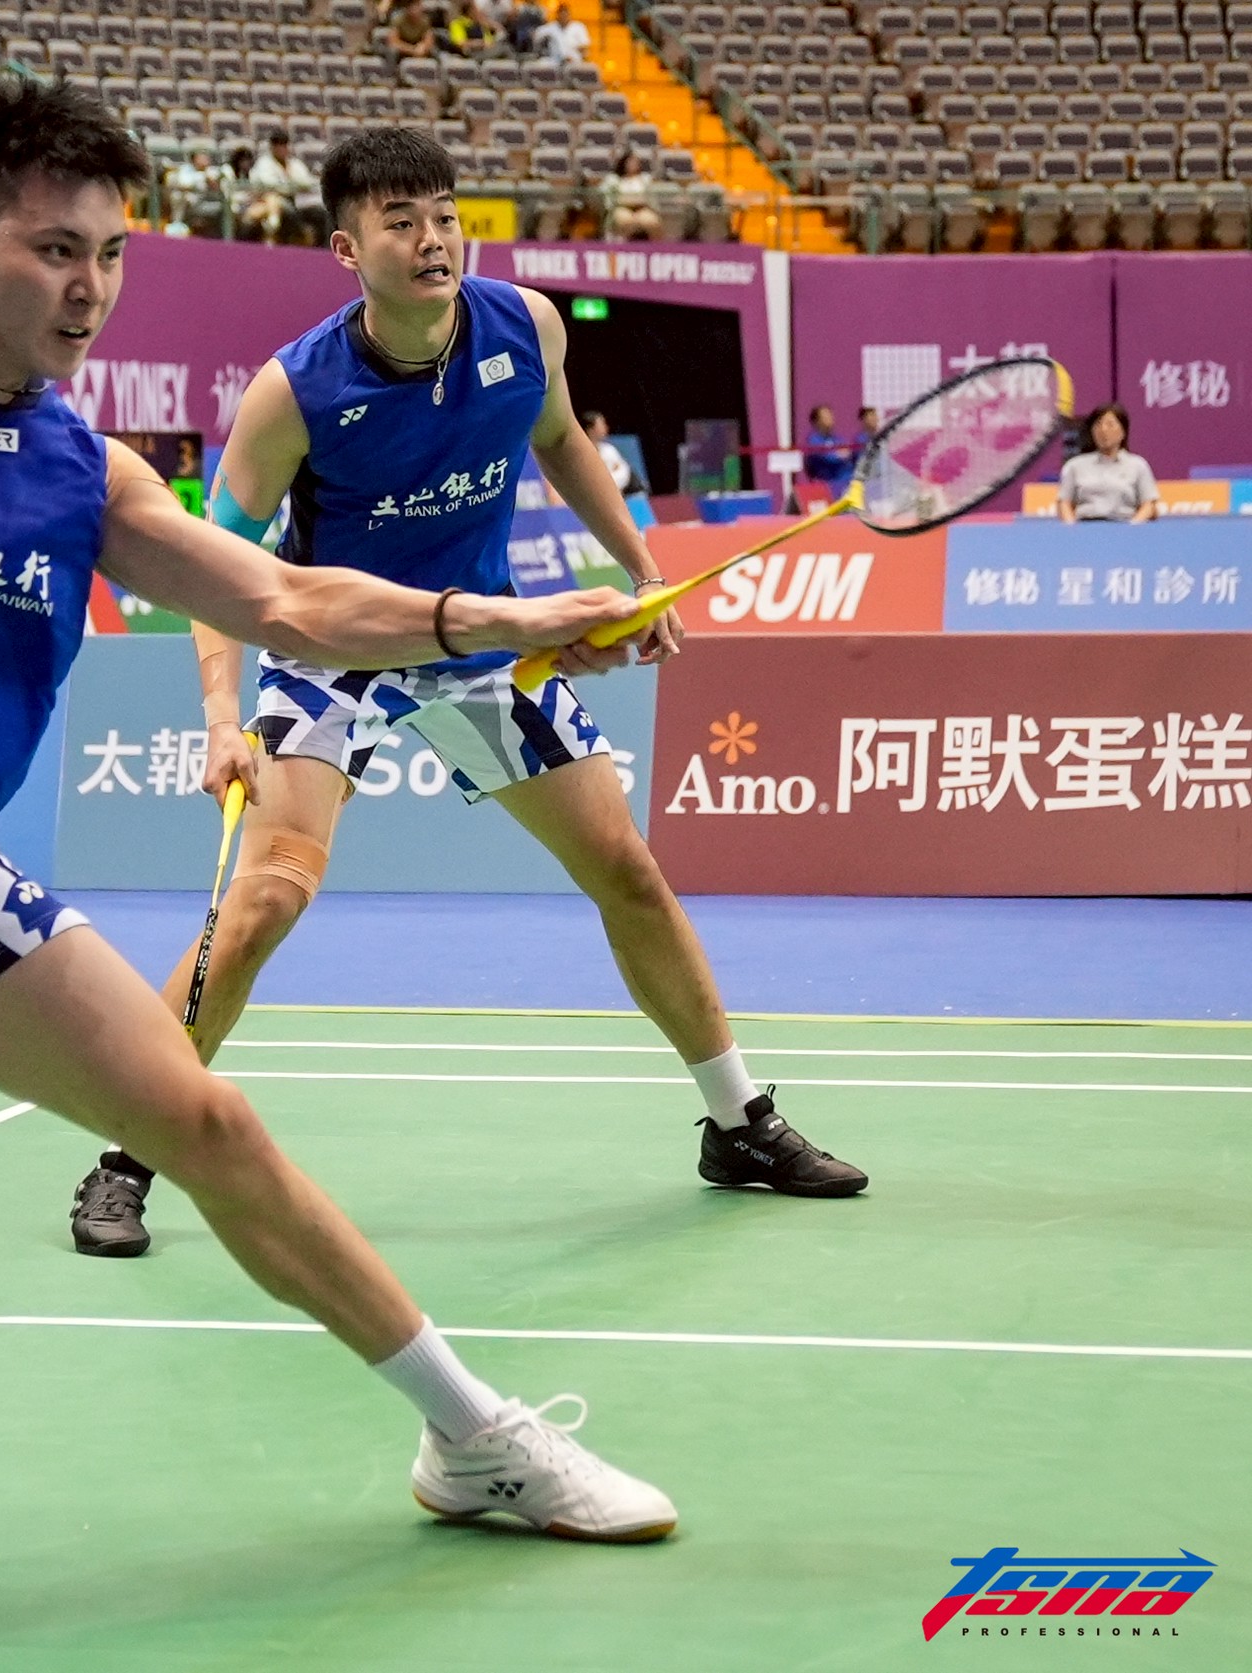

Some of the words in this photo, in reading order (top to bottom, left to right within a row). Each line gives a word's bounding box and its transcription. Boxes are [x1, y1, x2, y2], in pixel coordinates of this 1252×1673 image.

[109, 358, 191, 433] YONEX
[404, 504, 442, 518] BANK
[445, 498, 462, 513] OF
[708, 552, 875, 624] SUM
[76, 727, 211, 796] 太報
[665, 754, 816, 815] Amo
[836, 712, 1252, 813] 阿默蛋糕
[749, 1148, 776, 1167] YONEX
